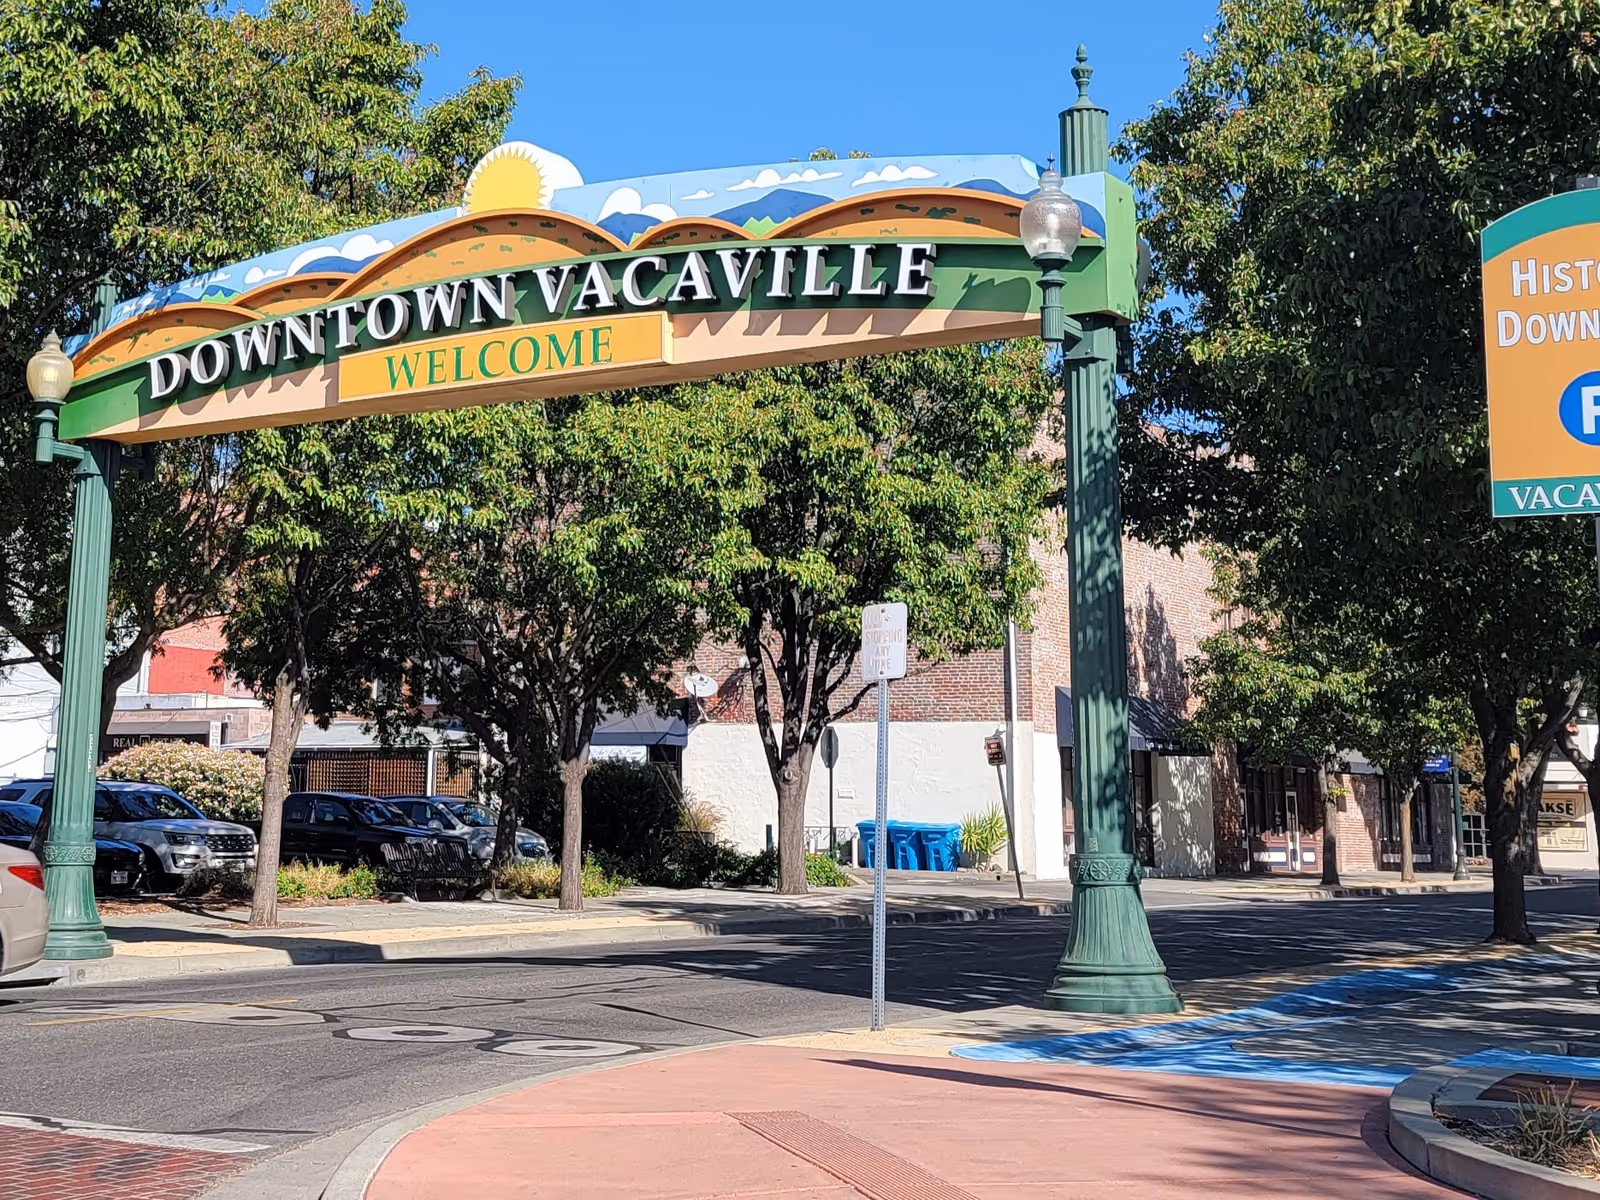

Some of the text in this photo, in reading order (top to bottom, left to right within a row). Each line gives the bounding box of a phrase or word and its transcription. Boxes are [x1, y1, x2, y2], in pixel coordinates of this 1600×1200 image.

[1511, 258, 1600, 297] HIST
[147, 243, 937, 399] DOWNTOWN VACAVILLE
[385, 326, 613, 397] WELCOME
[875, 645, 891, 657] ANY
